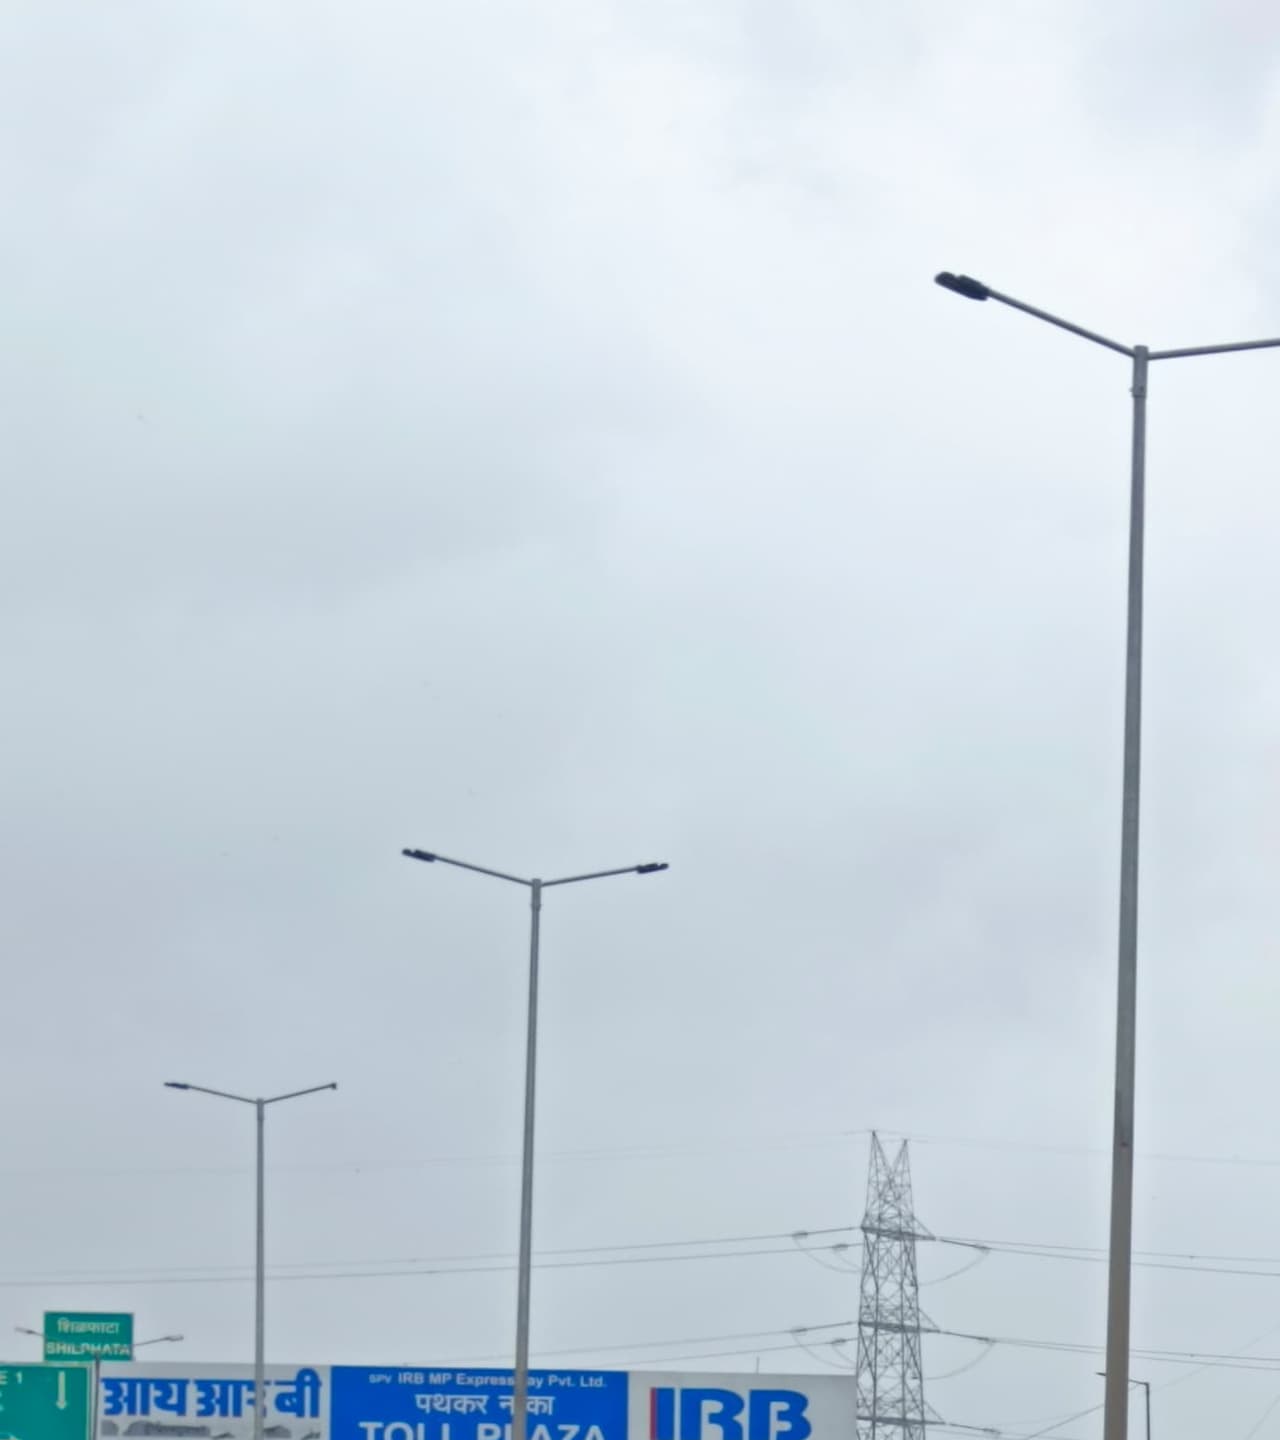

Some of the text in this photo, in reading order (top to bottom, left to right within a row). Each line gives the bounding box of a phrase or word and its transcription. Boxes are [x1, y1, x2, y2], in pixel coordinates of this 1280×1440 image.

[398, 1372, 424, 1385] IRB
[429, 1373, 452, 1385] MP
[456, 1373, 543, 1388] Expressay
[100, 1377, 190, 1416] आय
[274, 1367, 323, 1418] बी
[415, 1393, 489, 1414] पथकर
